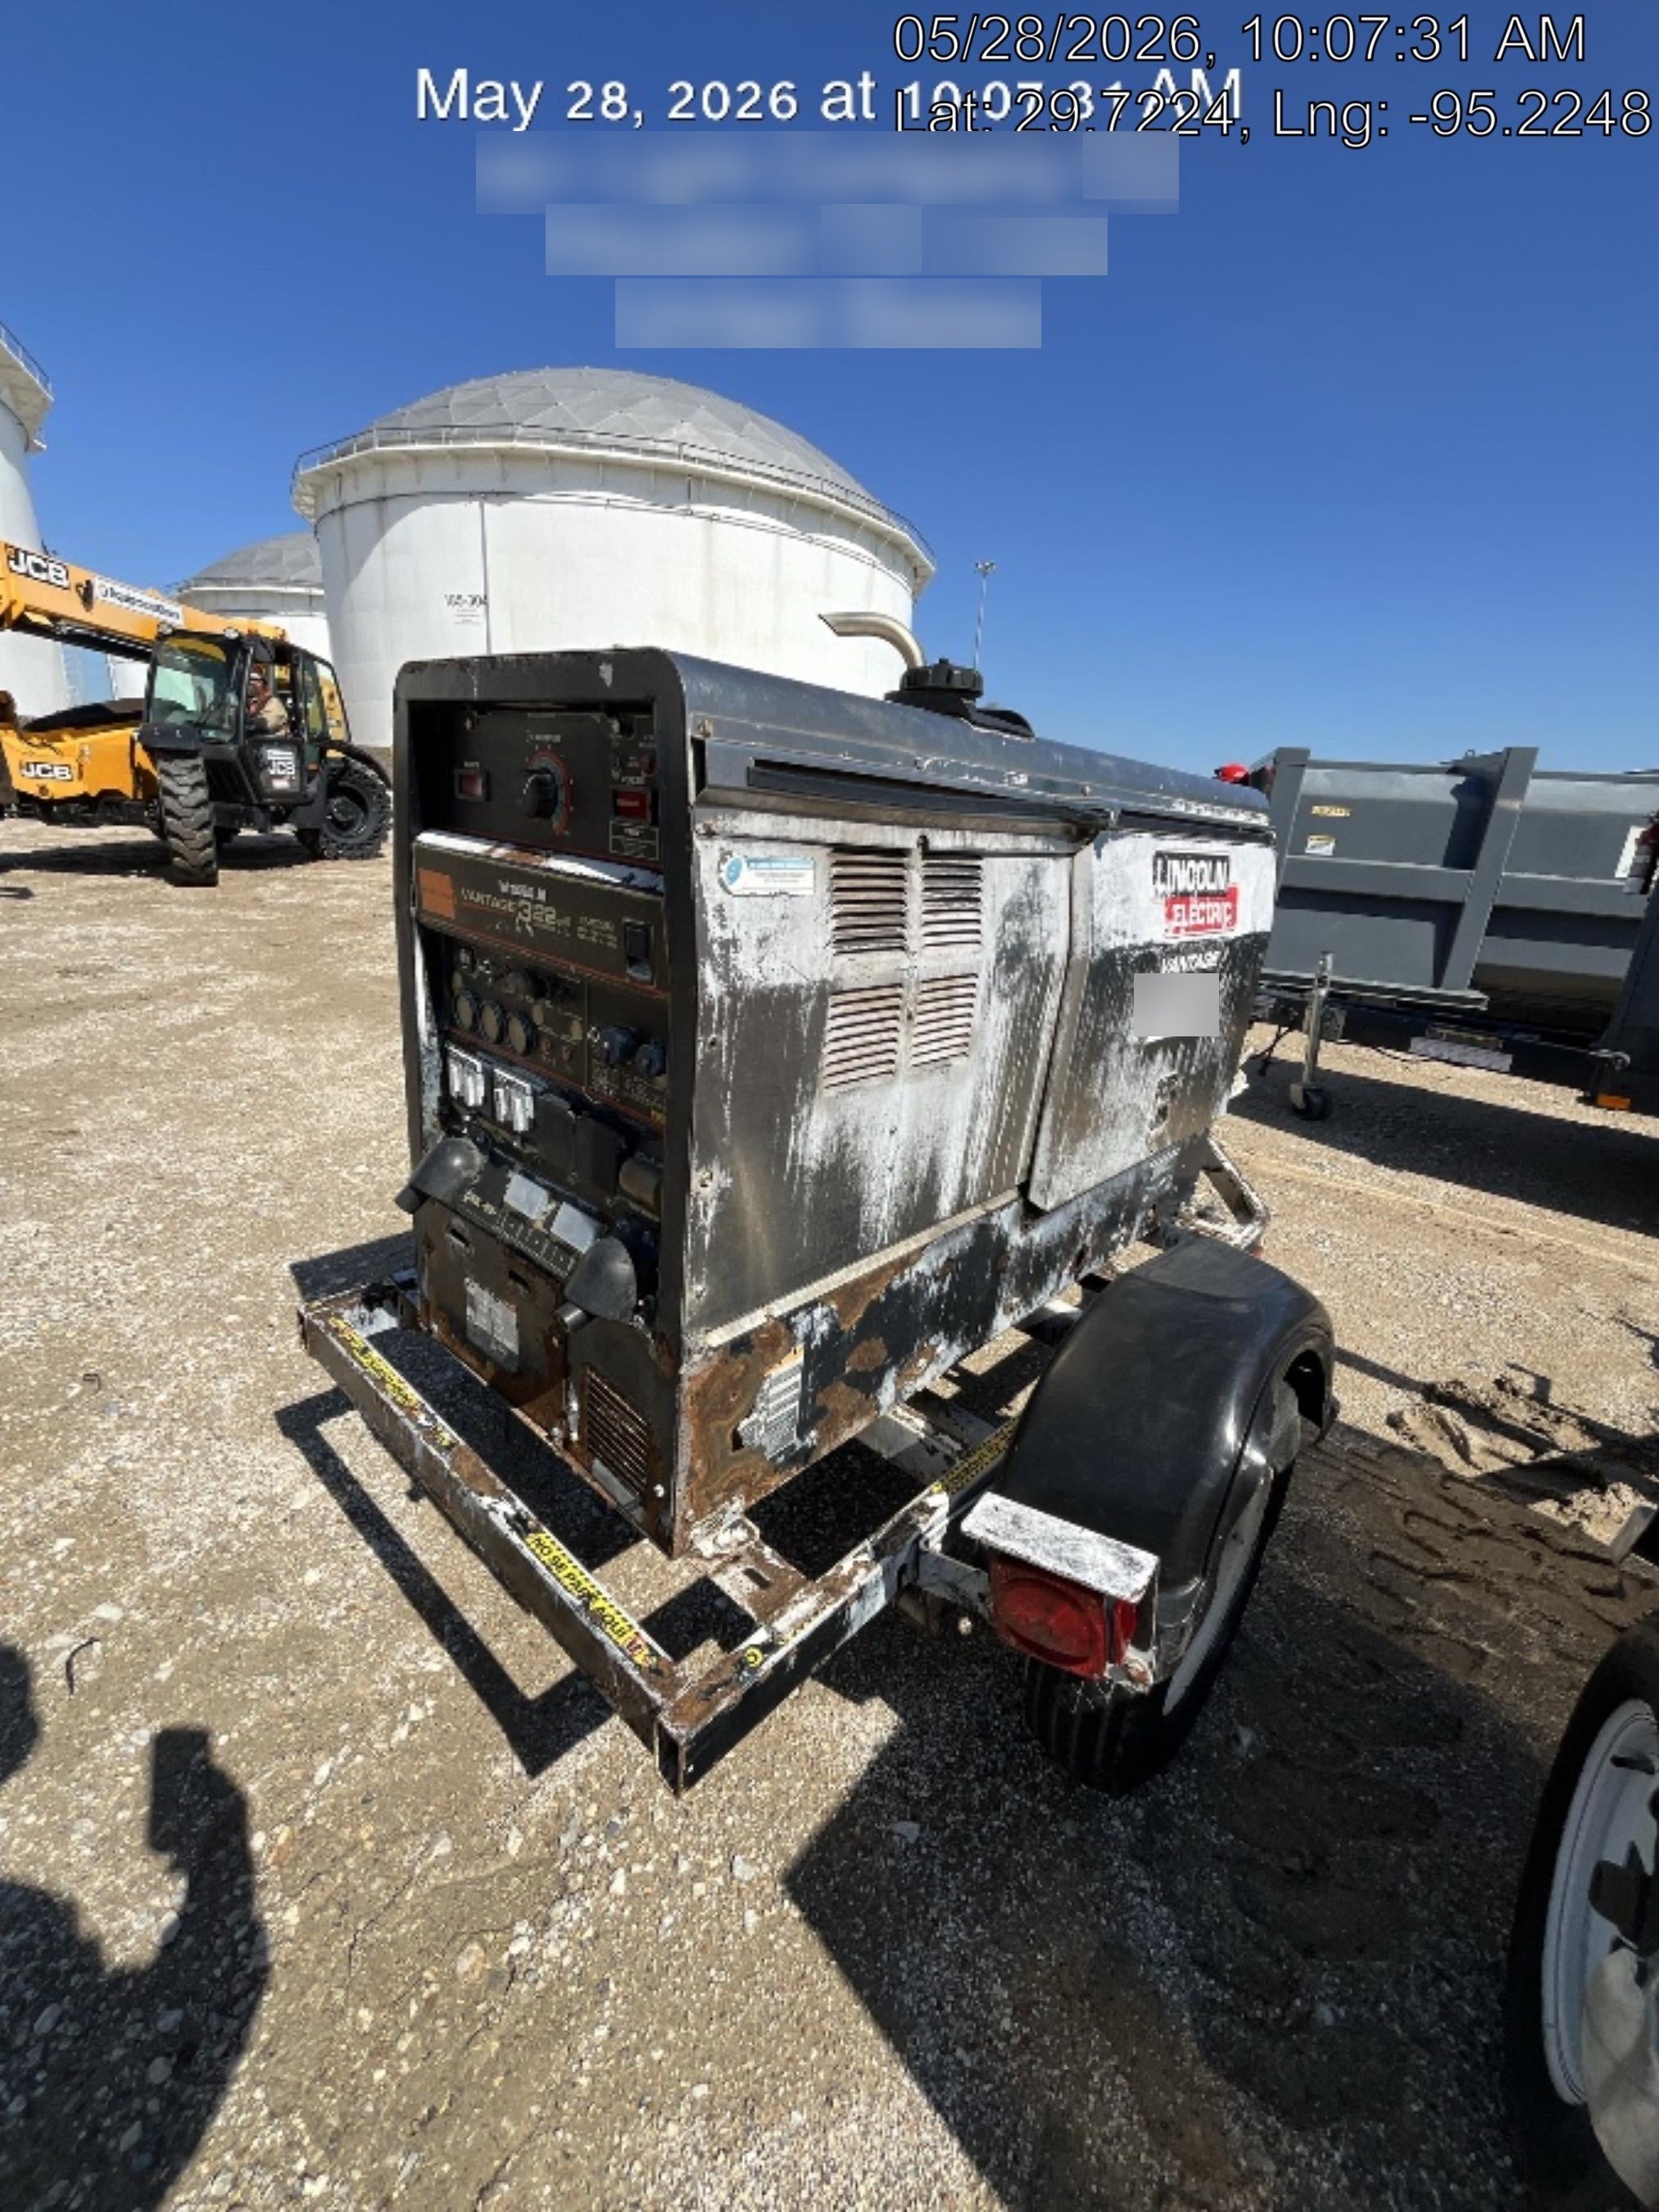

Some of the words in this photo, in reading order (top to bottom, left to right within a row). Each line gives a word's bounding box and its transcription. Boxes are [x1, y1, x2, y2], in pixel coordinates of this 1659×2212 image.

[9, 550, 69, 589] JCB
[21, 763, 72, 780] JCB
[268, 760, 296, 775] JCB
[1155, 858, 1227, 894] LINCOLN
[1172, 900, 1234, 927] ELECTRIC
[533, 1536, 554, 1557] NO
